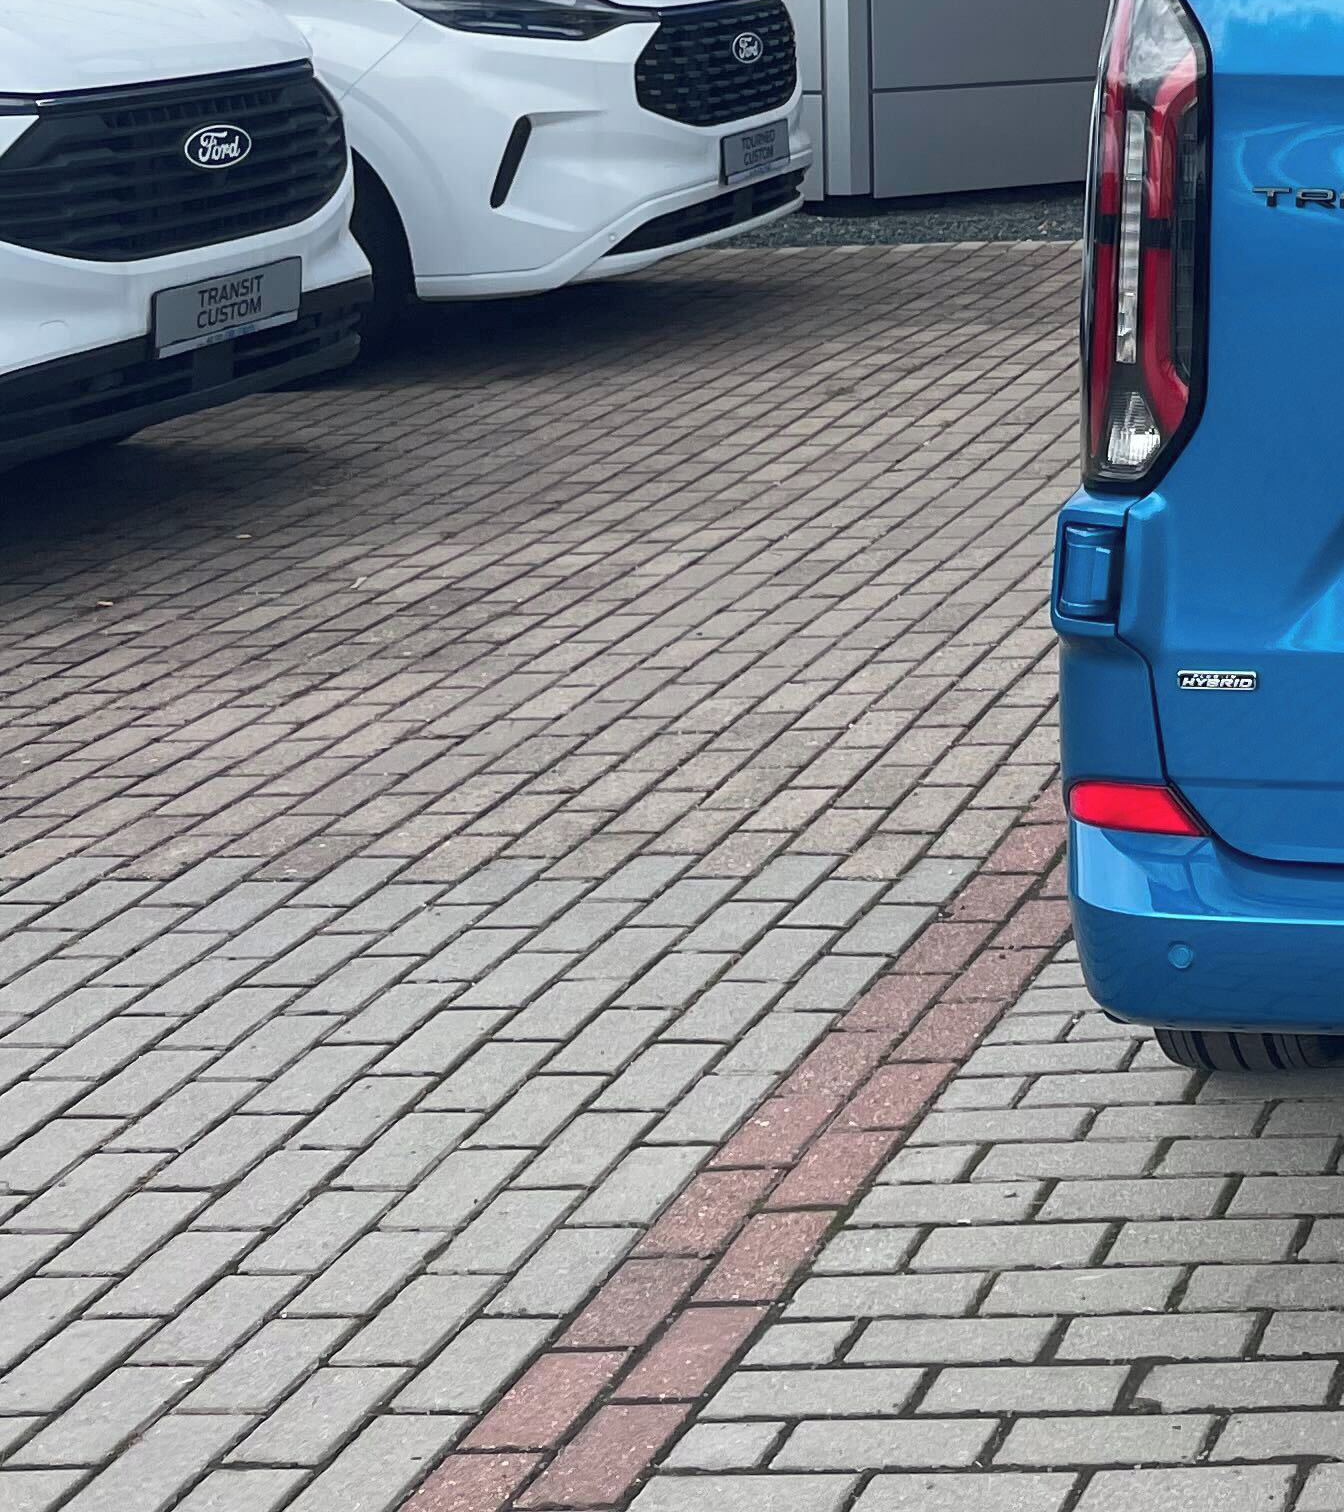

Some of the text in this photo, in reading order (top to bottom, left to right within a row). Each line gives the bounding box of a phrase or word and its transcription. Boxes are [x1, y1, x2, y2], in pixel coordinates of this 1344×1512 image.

[738, 36, 759, 59] Ford
[198, 131, 241, 162] Ford
[198, 274, 264, 308] TRANSIT
[196, 296, 262, 329] CUSTOM
[1182, 677, 1253, 688] HYBRID
